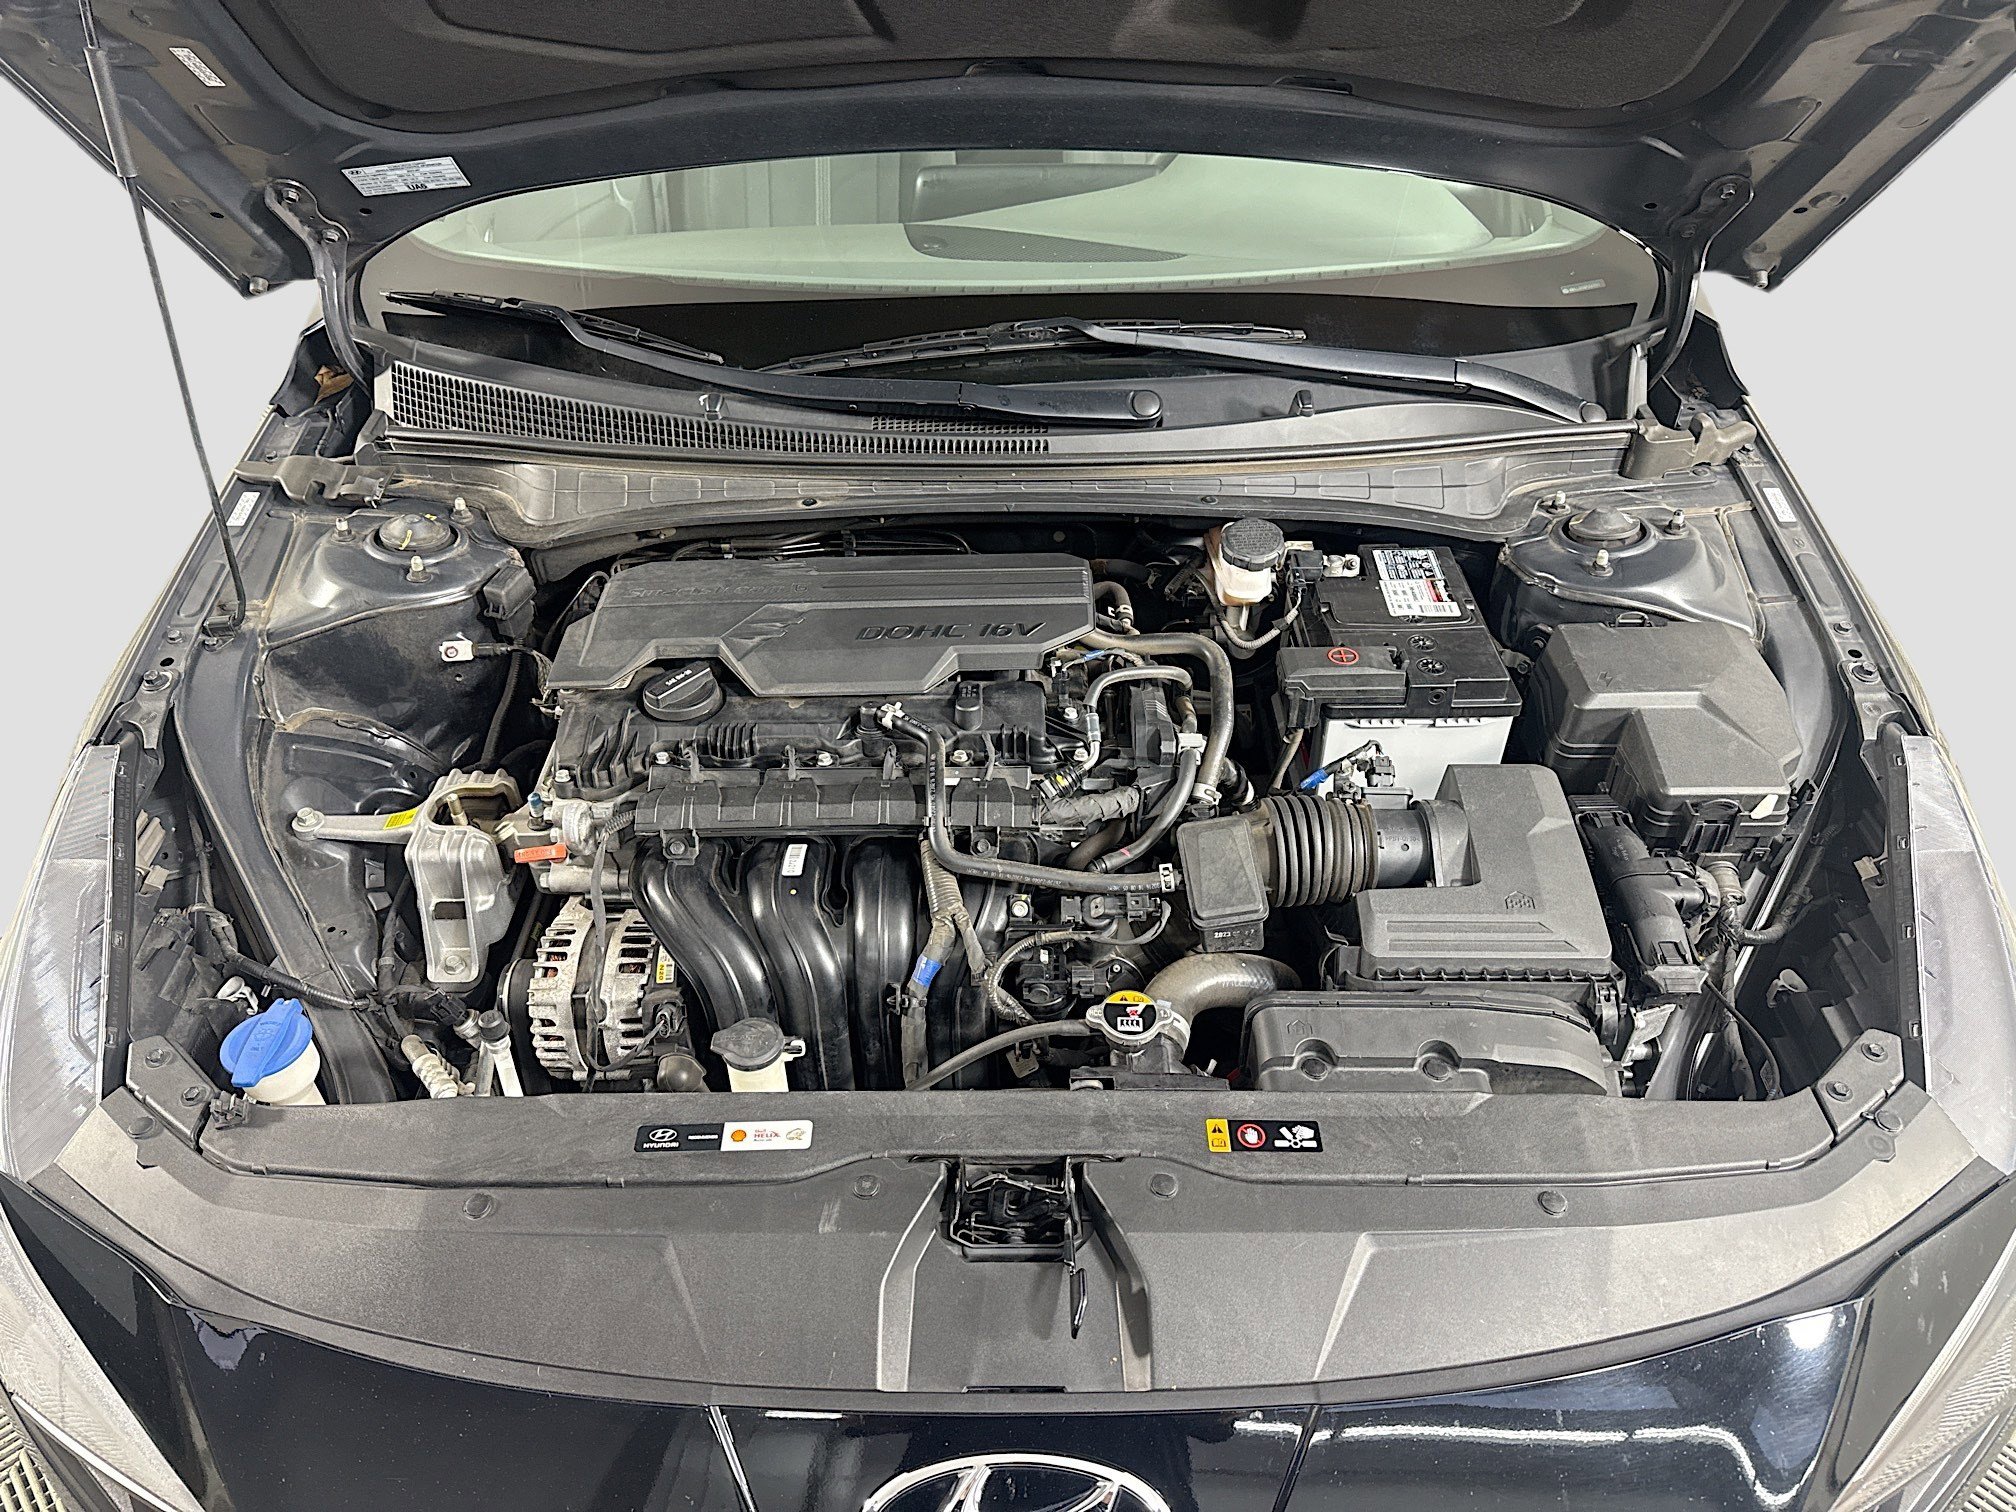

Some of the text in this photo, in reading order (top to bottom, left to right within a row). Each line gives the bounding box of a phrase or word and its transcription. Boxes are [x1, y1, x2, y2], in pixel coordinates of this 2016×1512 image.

[855, 622, 1047, 641] DOHC 16V
[642, 1141, 680, 1149] HYUNDAI
